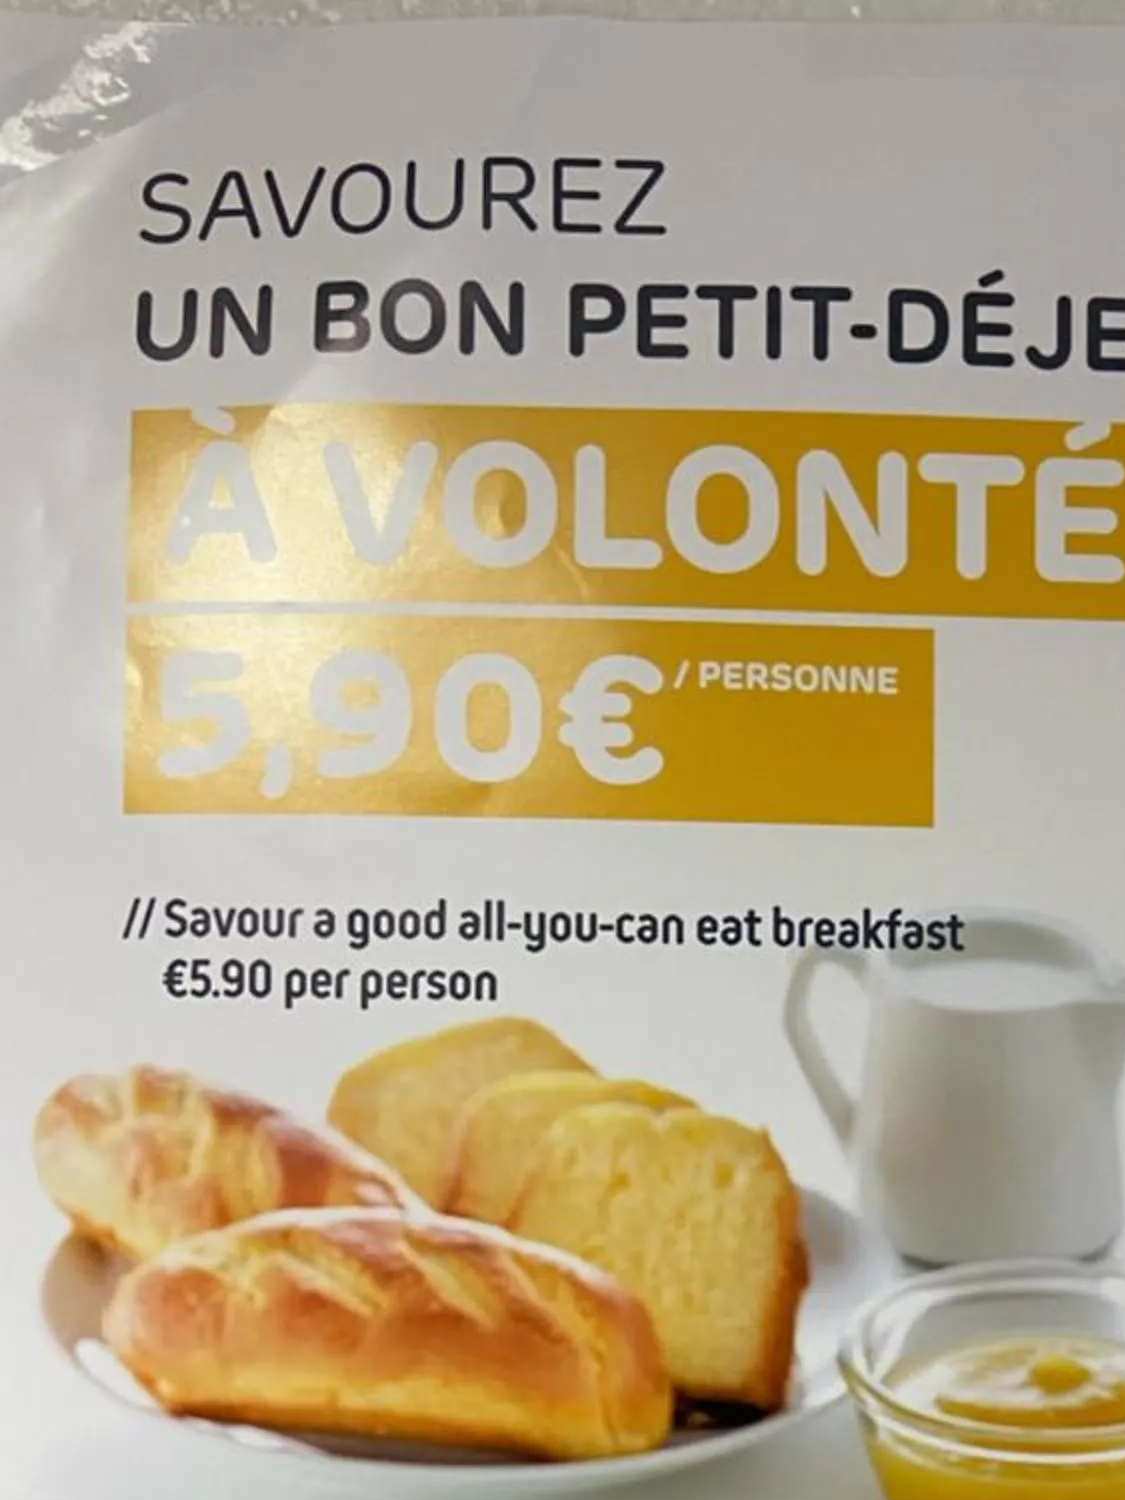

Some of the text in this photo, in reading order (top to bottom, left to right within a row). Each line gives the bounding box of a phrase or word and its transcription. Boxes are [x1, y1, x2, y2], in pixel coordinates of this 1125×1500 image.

[139, 156, 667, 244] SAVOUREZ
[136, 284, 273, 362] UN
[314, 278, 525, 356] BON
[165, 409, 278, 571] À
[153, 650, 898, 799] 5,90€ / PERSONNE
[165, 898, 304, 938] Savour
[313, 908, 336, 939] a
[347, 898, 446, 950] good
[458, 900, 684, 953] all-you-can
[697, 909, 762, 947] eat
[771, 903, 965, 953] breakfast
[163, 959, 497, 1010] €5.90 per person
